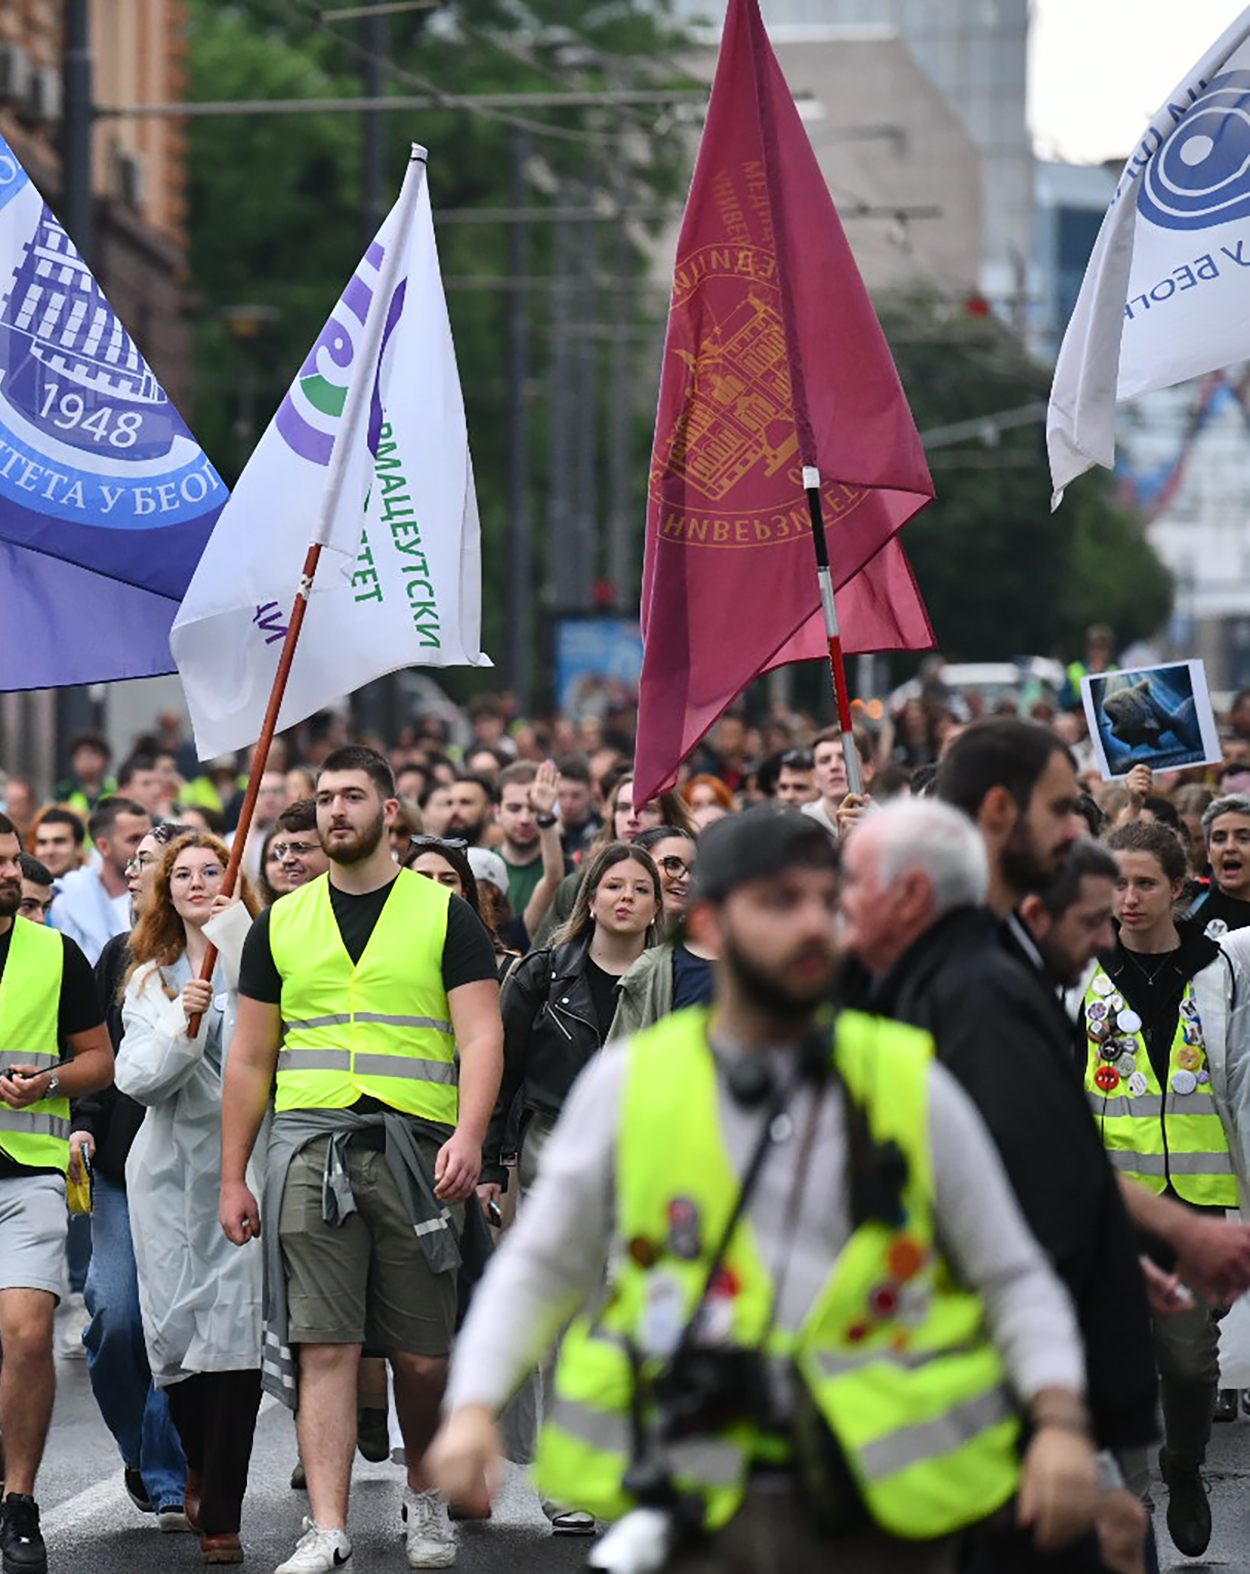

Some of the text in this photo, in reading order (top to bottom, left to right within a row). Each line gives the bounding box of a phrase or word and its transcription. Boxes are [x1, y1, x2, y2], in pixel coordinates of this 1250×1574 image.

[39, 382, 143, 448] 1948
[100, 484, 129, 514] У
[351, 532, 383, 602] ТЕТ
[375, 418, 441, 650] РМАЦЕУТСКИ
